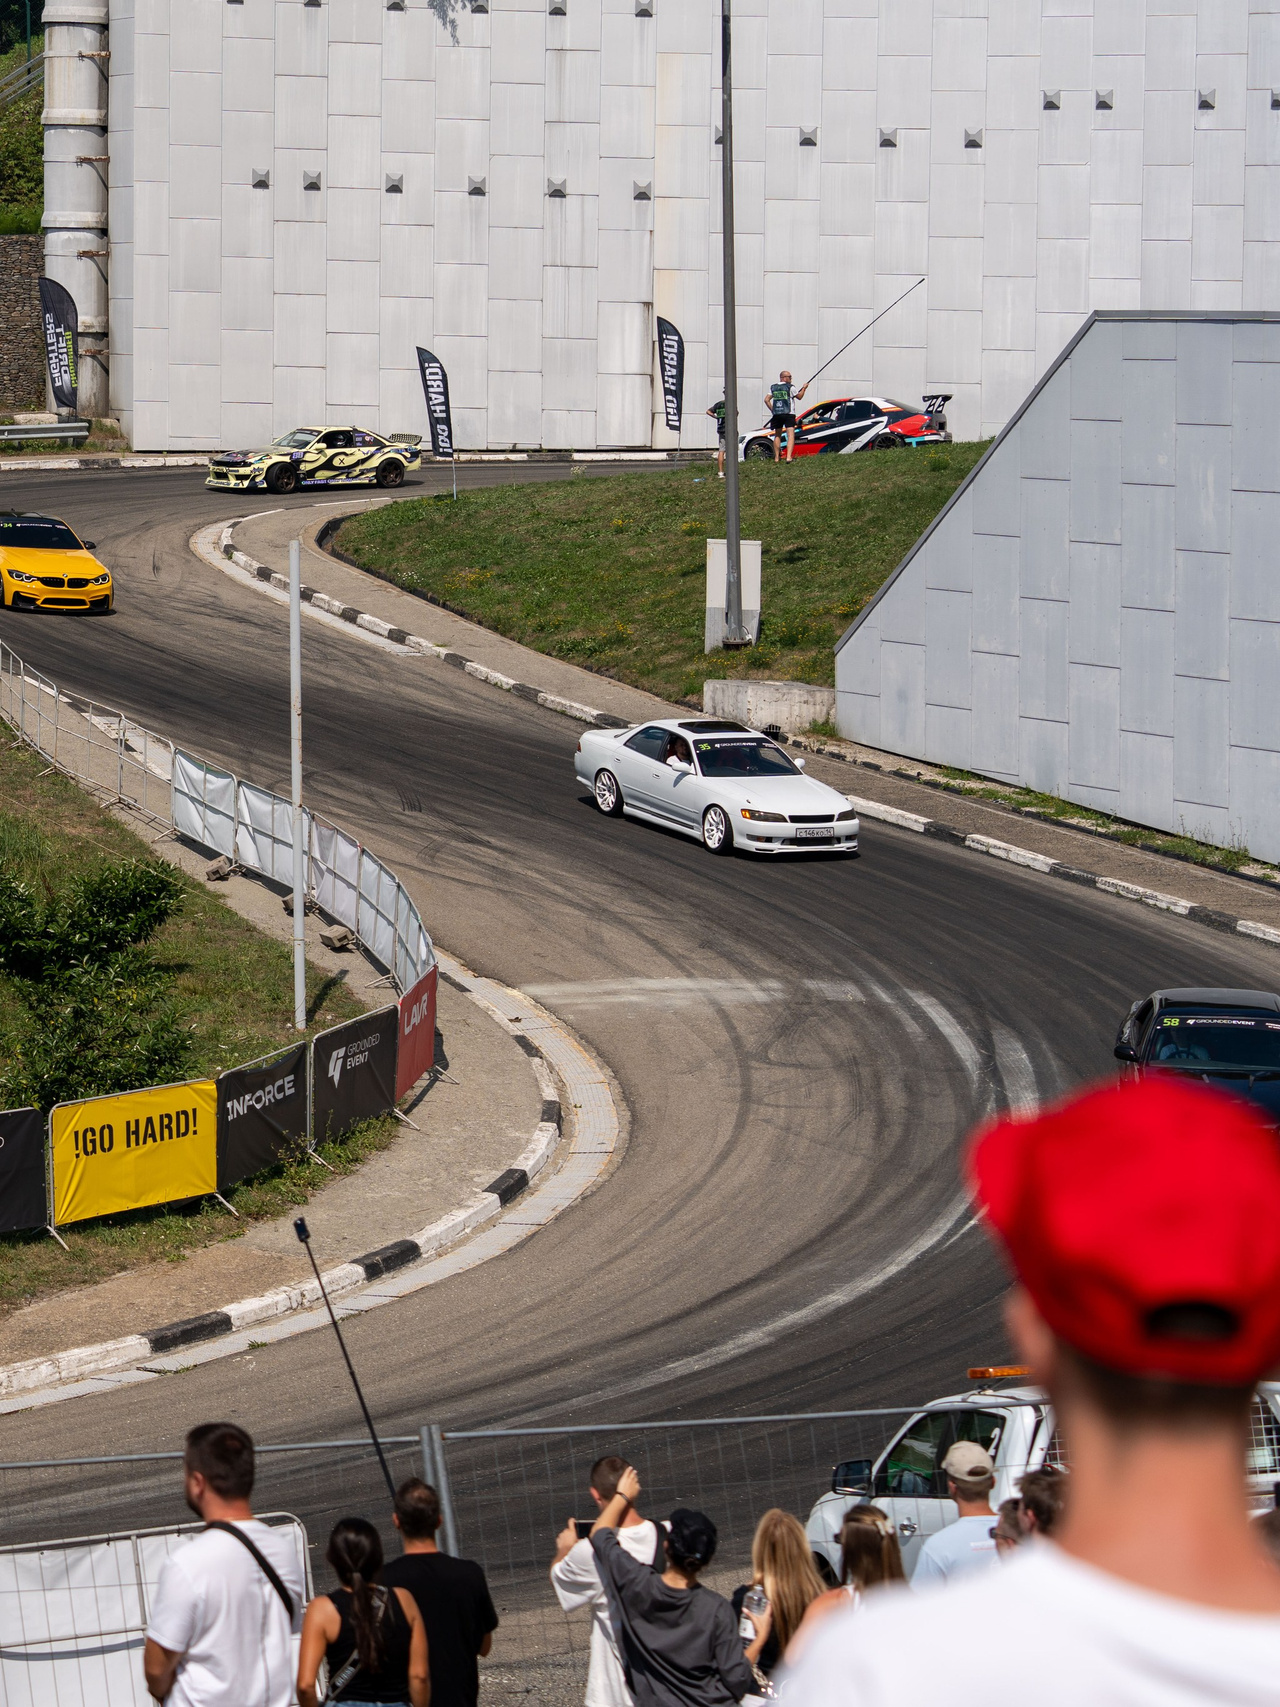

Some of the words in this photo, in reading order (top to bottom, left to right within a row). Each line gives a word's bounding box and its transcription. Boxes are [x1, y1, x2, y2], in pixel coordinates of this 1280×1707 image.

[698, 742, 711, 750] 35
[1163, 1018, 1179, 1026] 58
[347, 1033, 380, 1055] GROUNDED
[346, 1052, 369, 1069] EVENT
[226, 1074, 296, 1121] INFORCE
[74, 1123, 114, 1159] !GO
[125, 1108, 198, 1148] HARD!
